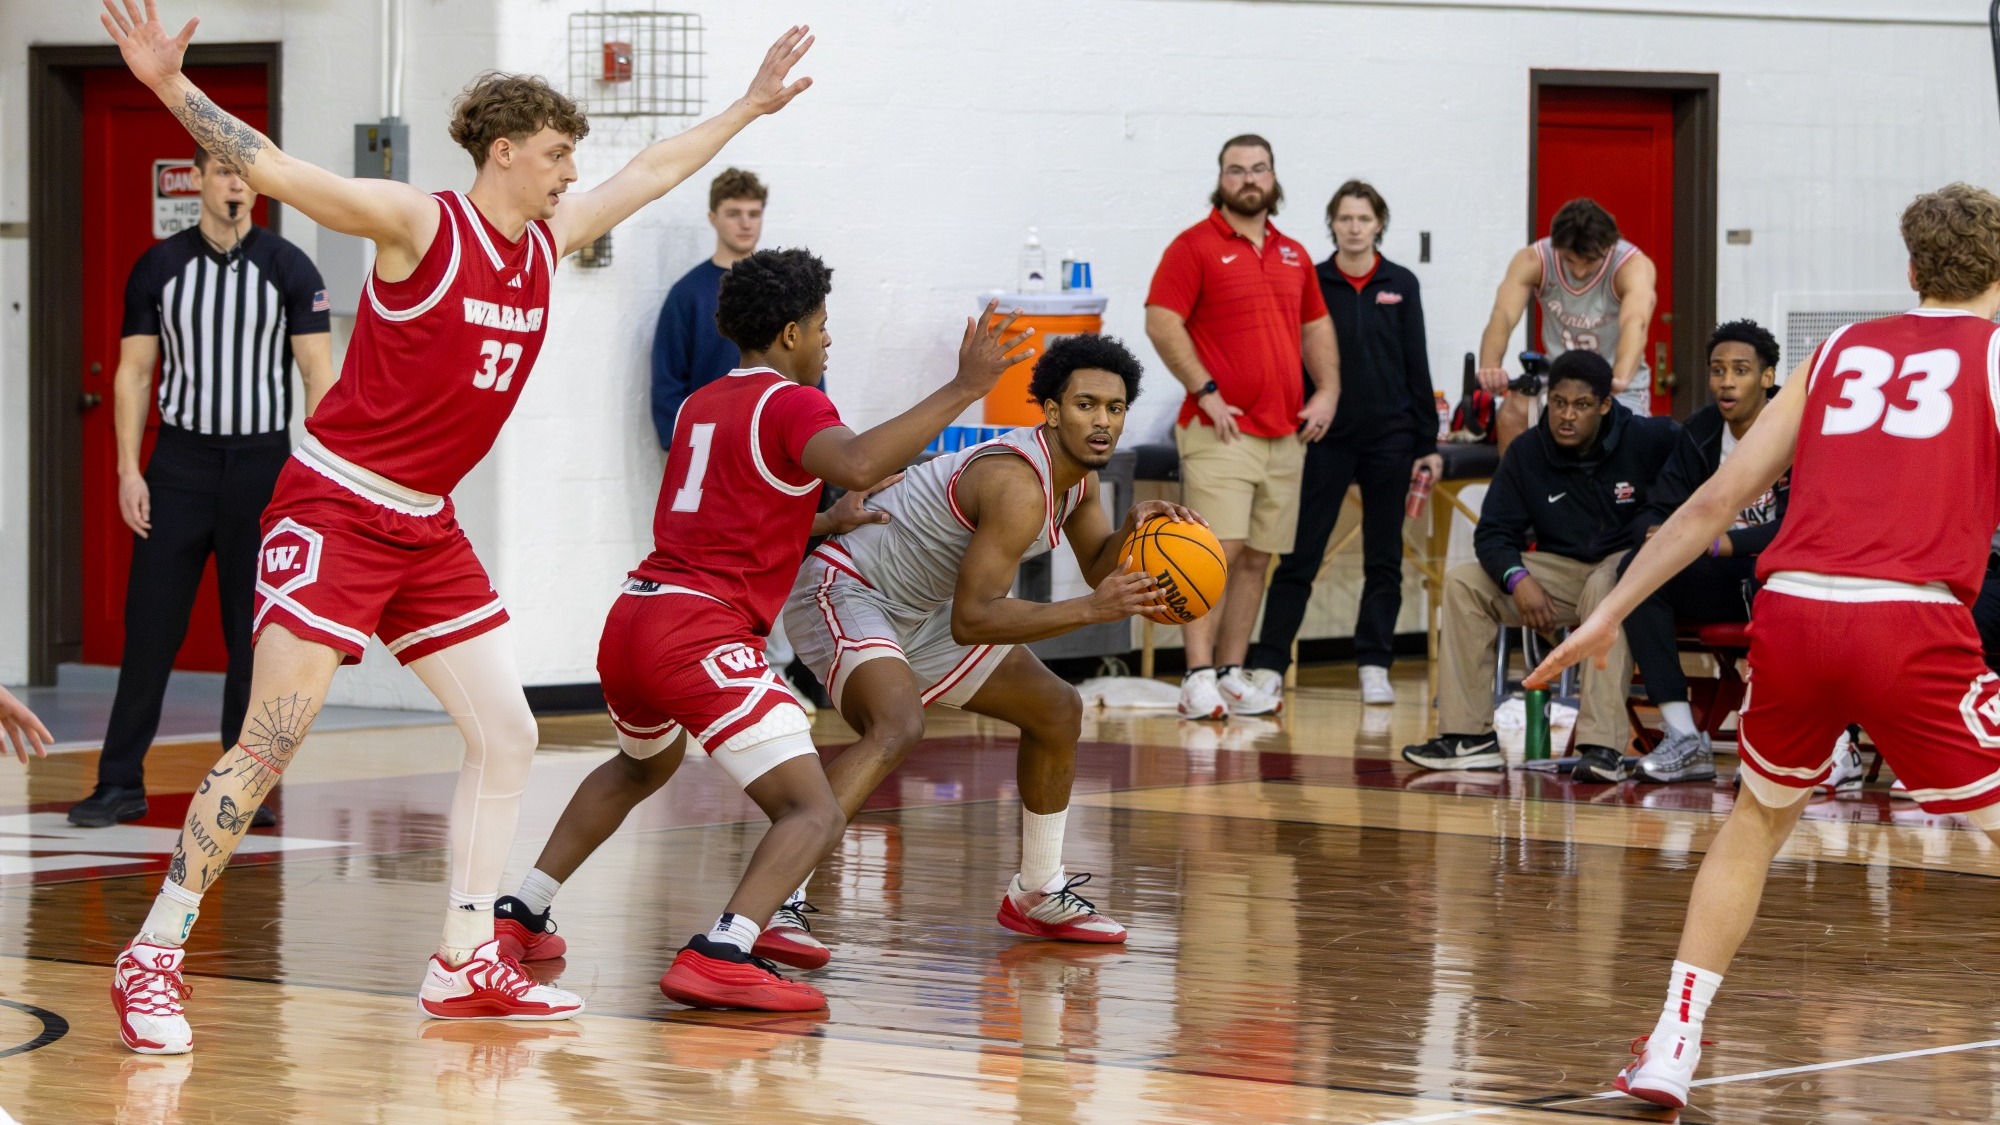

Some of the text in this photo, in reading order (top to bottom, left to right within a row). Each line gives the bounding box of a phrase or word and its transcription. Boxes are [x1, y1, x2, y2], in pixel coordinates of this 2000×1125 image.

[164, 172, 193, 192] DAN
[174, 203, 199, 215] HIG
[1821, 345, 1961, 439] 33
[671, 423, 716, 513] 1
[1155, 569, 1197, 623] Wilson
[188, 812, 222, 858] MMIV
